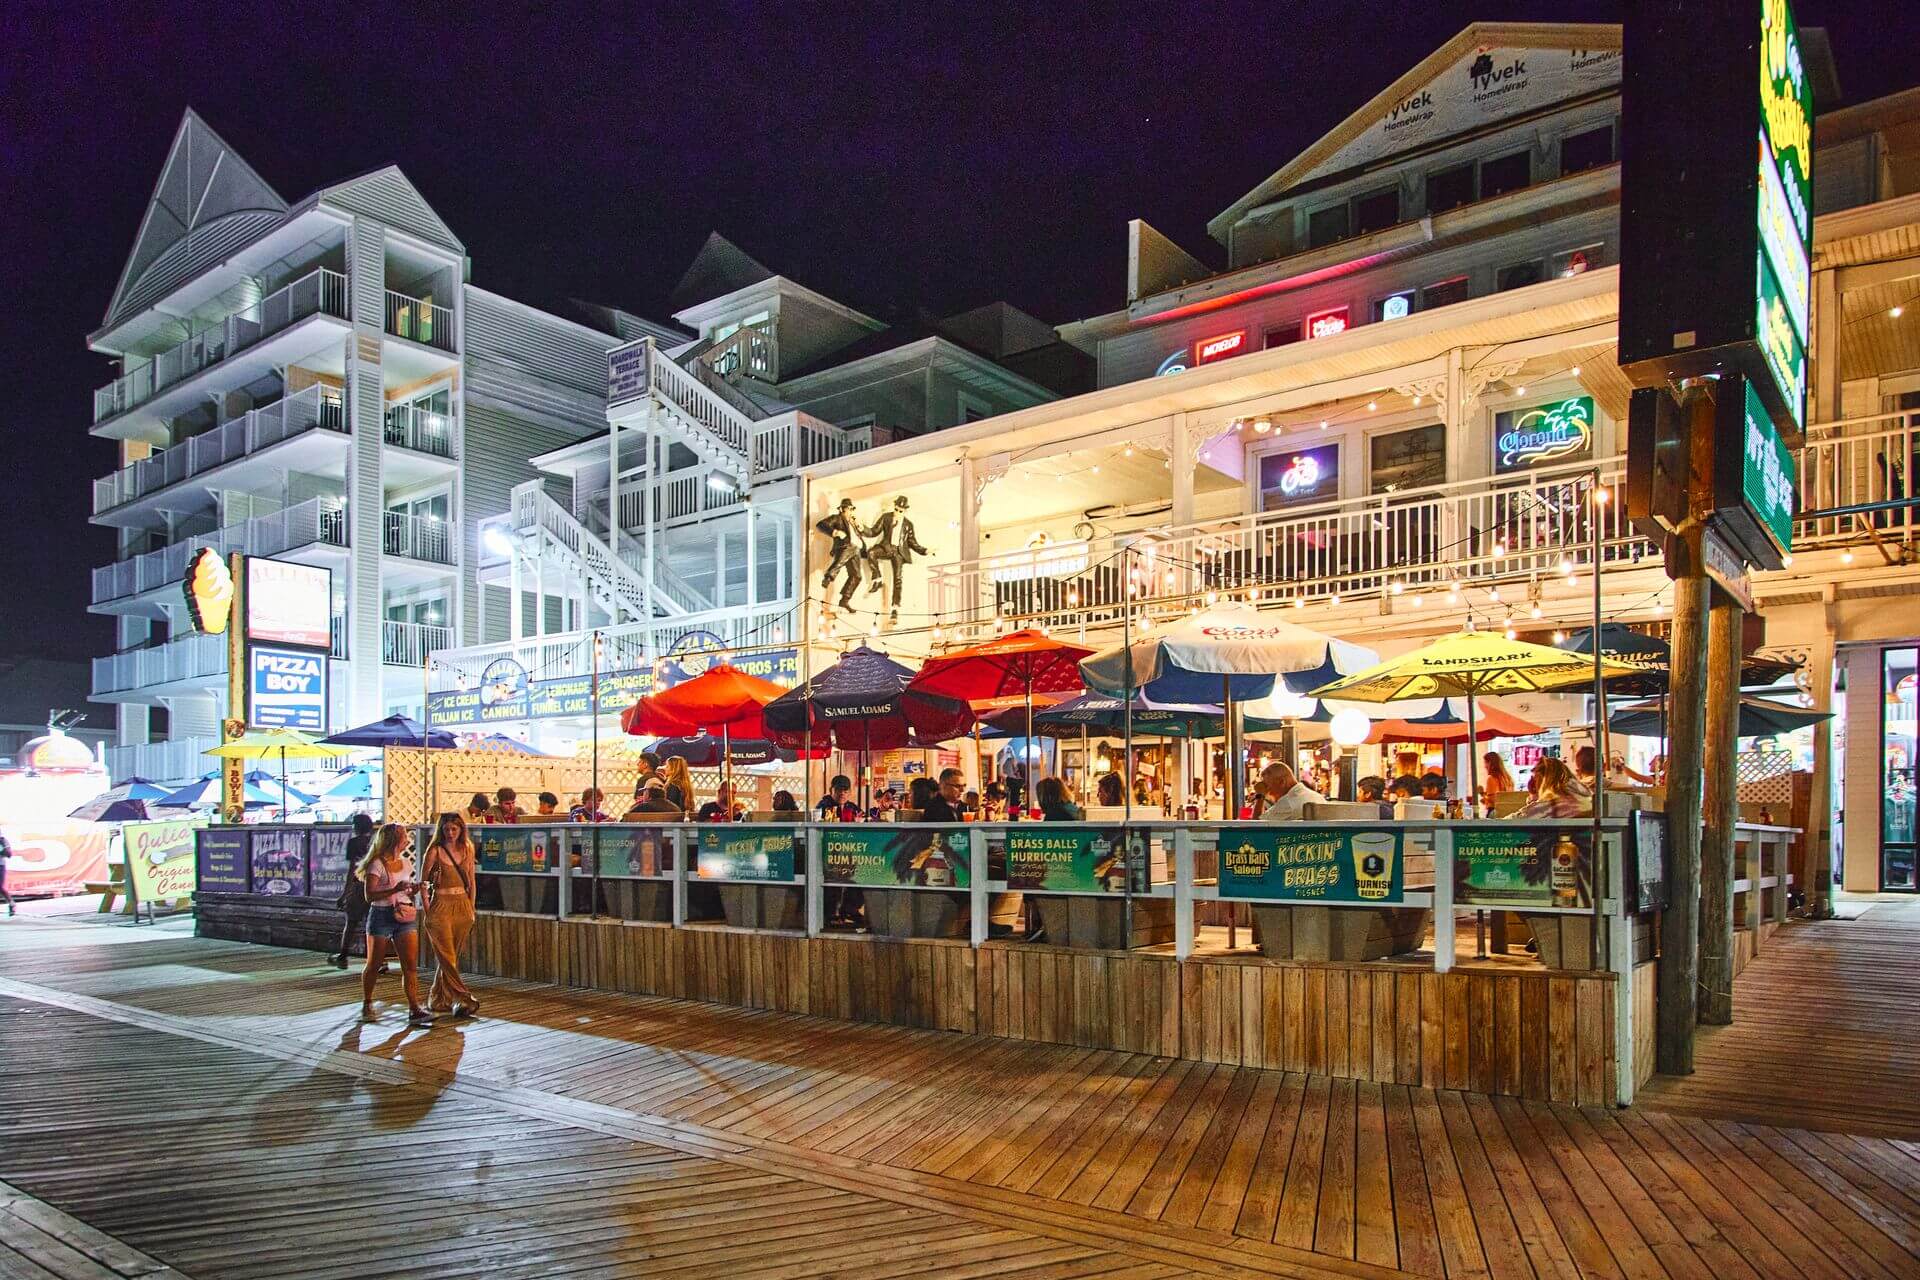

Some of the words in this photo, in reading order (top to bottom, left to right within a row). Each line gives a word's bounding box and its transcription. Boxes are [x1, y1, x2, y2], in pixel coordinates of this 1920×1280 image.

[1473, 80, 1528, 103] HomeWrap
[1385, 91, 1432, 120] yvek
[1384, 111, 1434, 132] HomeWrap
[1499, 429, 1567, 452] Corona
[1202, 626, 1280, 635] Coors
[256, 654, 320, 676] PIZZA
[1422, 652, 1533, 665] LANDSHARK
[734, 660, 772, 675] GYROS
[266, 673, 311, 692] BOY
[444, 696, 455, 708] ICE
[456, 694, 480, 707] CREAM
[432, 711, 460, 724] ITALIAN
[462, 709, 474, 720] ICE
[481, 703, 527, 719] CANNOLI
[532, 700, 563, 715] FUNNEL
[565, 698, 587, 712] CAKE
[824, 706, 859, 717] SAMUEL
[860, 703, 891, 715] ADAMS
[745, 751, 766, 759] ADAMS
[253, 833, 280, 859] PIZZA
[317, 833, 349, 854] PIZZ
[828, 842, 868, 851] DONKEY
[1011, 839, 1043, 849] BRASS
[1046, 839, 1078, 849] BALLS
[1011, 852, 1073, 862] HURRICANE
[1278, 838, 1343, 865] KICKIN'
[1458, 847, 1485, 855] RUM
[1487, 847, 1537, 856] RUNNER
[828, 855, 850, 864] RUM
[851, 855, 886, 865] PUNCH
[1225, 852, 1247, 866] Brass
[1248, 852, 1270, 866] Balls
[1233, 864, 1262, 875] Saloon
[1284, 866, 1339, 887] BRASS
